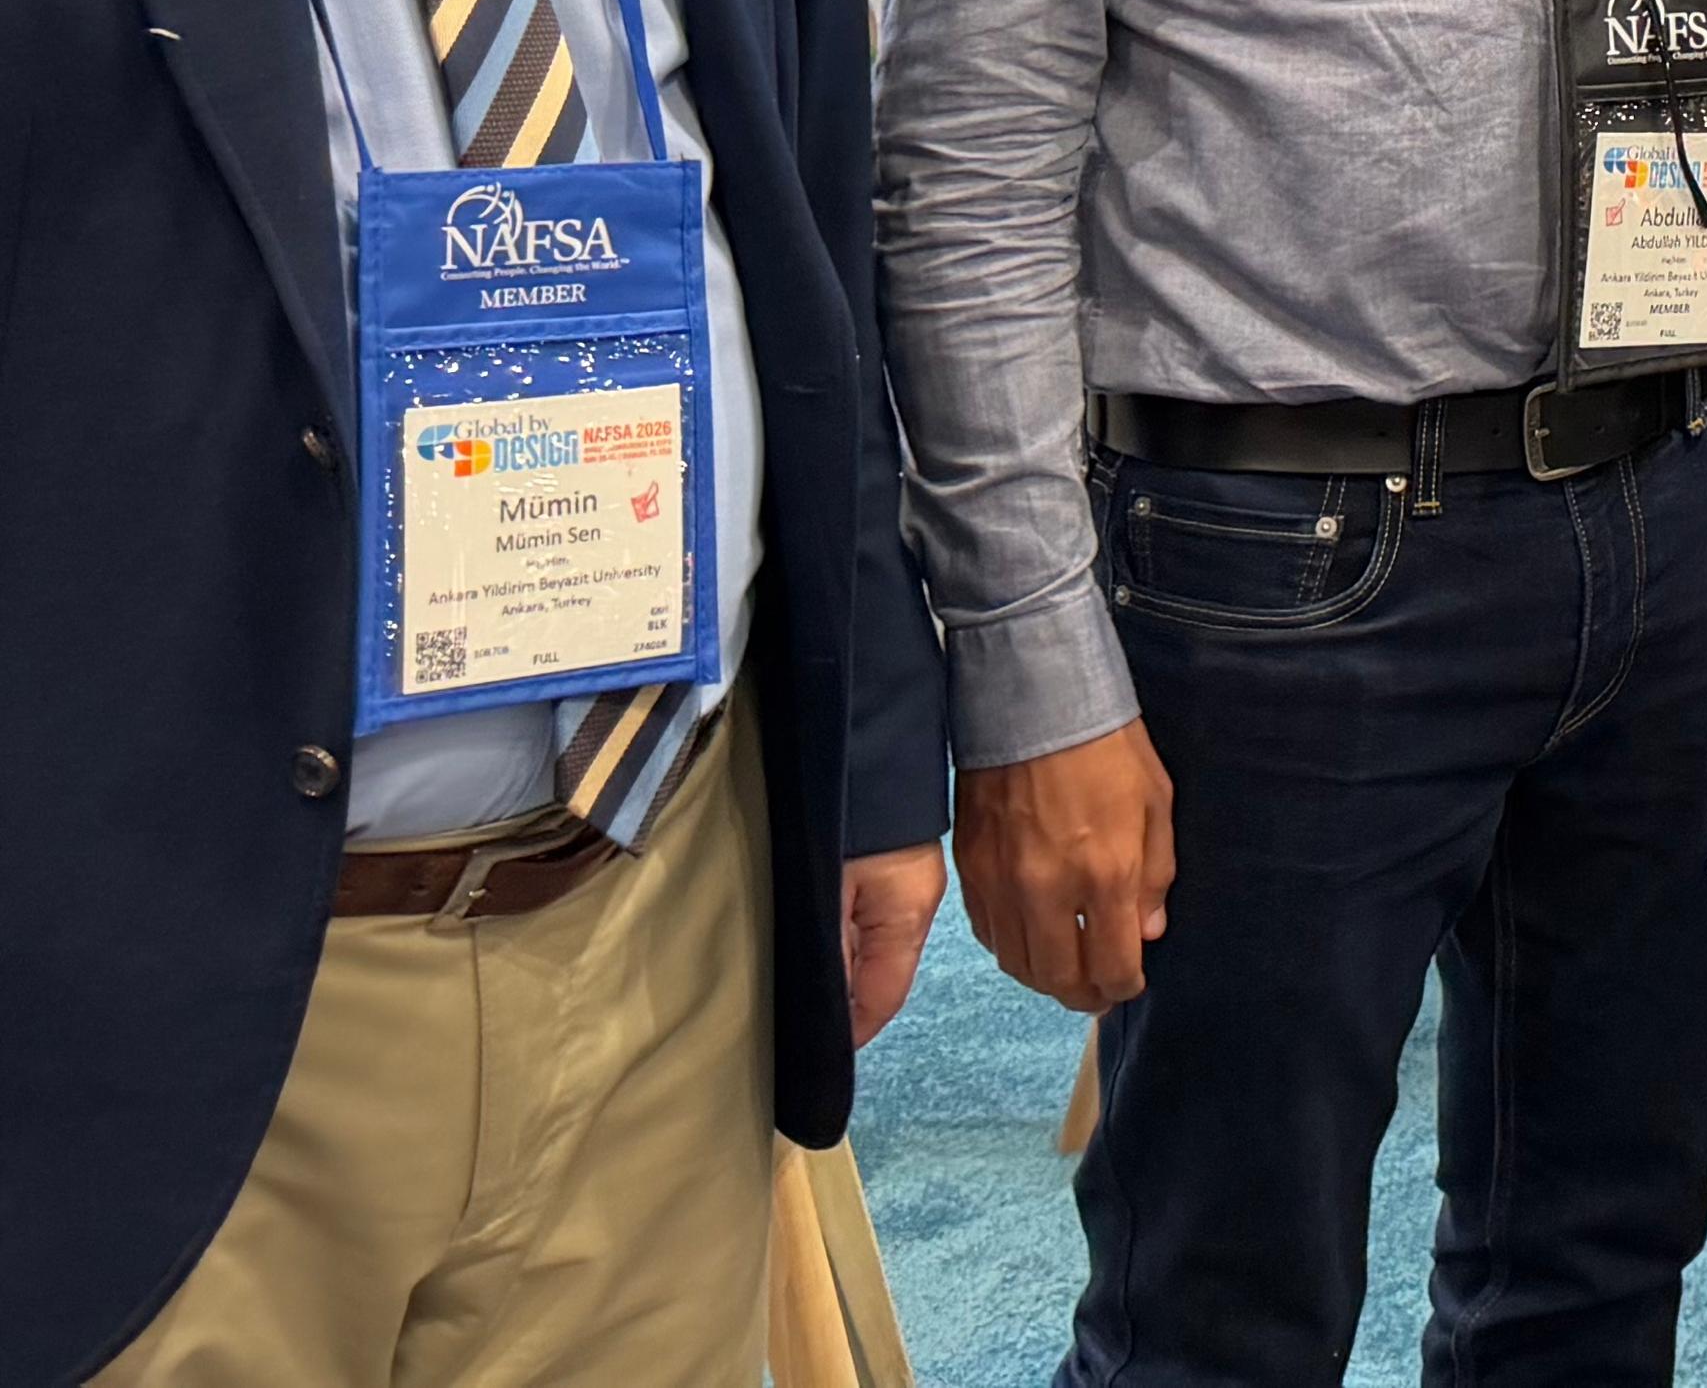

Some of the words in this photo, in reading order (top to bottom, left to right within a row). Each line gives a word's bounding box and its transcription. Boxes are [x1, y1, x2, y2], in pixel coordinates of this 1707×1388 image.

[1627, 145, 1670, 160] Global
[1640, 207, 1707, 227] Abdulla
[439, 216, 618, 270] NAFSA
[1631, 235, 1681, 250] Abdullah
[529, 262, 574, 275] Changing
[575, 261, 590, 271] the
[479, 283, 587, 310] MEMBER
[1650, 303, 1691, 315] MEMBER
[454, 415, 524, 440] Global
[529, 414, 553, 434] by
[583, 424, 633, 444] NAFSA
[636, 420, 672, 439] 2026
[500, 491, 598, 524] Mümin
[496, 532, 563, 553] Mümin
[568, 525, 602, 546] Sen
[428, 589, 479, 606] Ankara
[482, 582, 535, 599] Yildirim
[539, 573, 590, 593] Beyazit
[593, 562, 662, 583] University
[501, 599, 550, 616] Ankara,
[551, 595, 593, 611] Turkey
[533, 652, 560, 666] FULL
